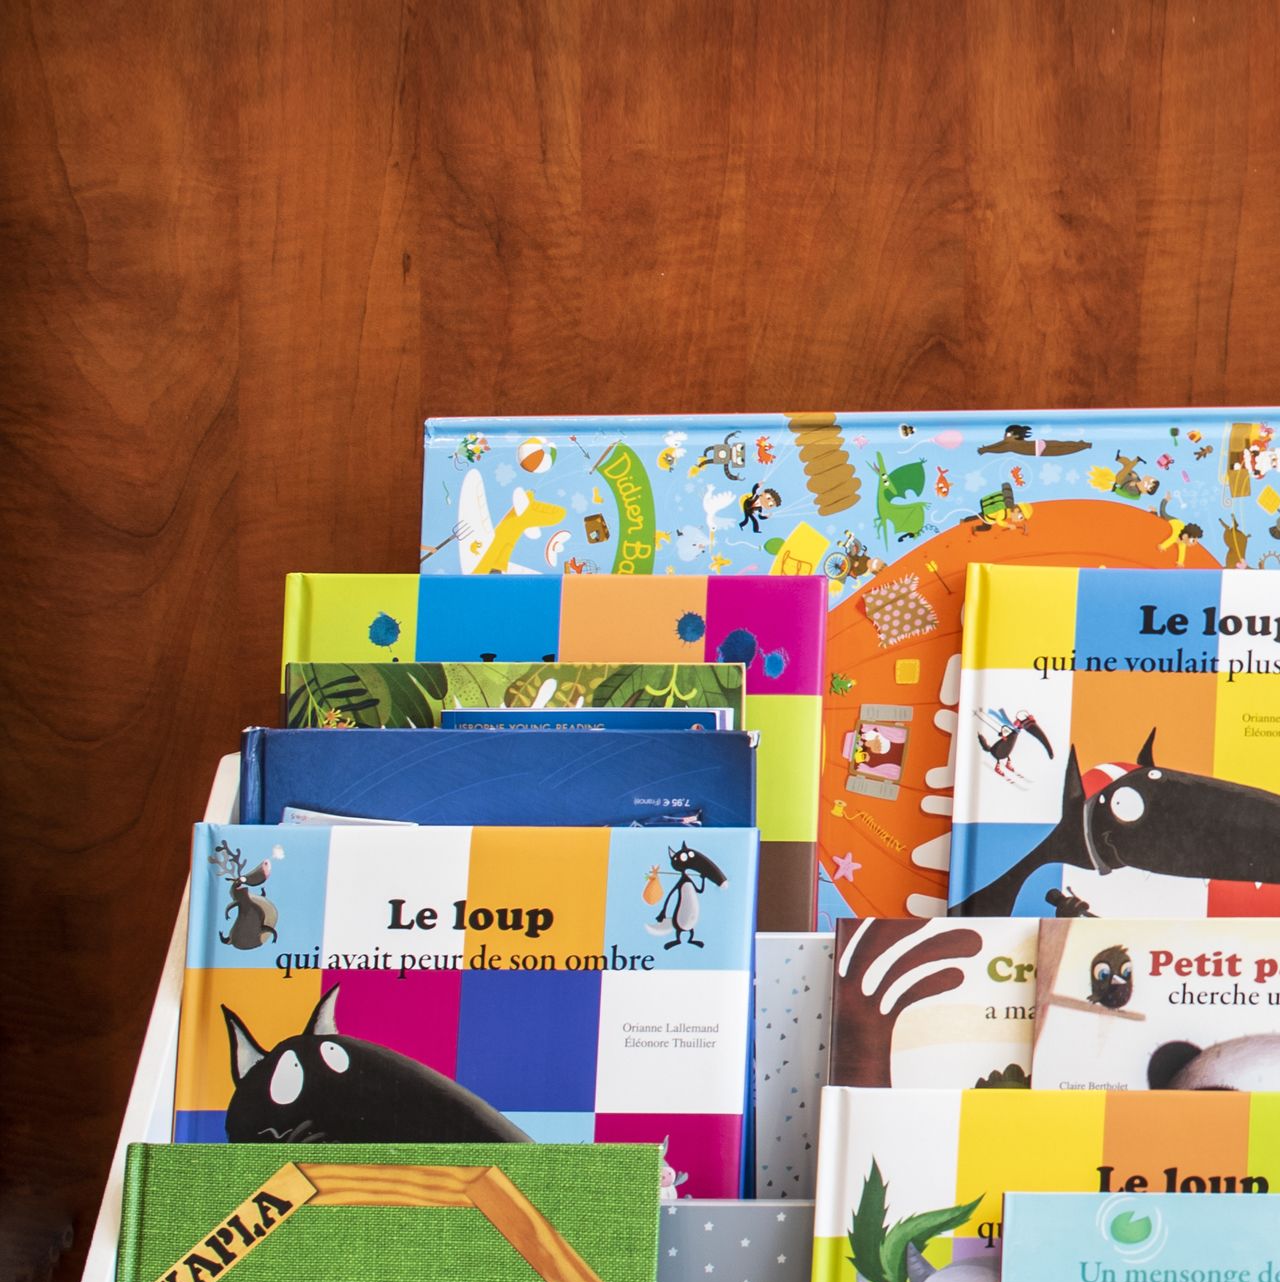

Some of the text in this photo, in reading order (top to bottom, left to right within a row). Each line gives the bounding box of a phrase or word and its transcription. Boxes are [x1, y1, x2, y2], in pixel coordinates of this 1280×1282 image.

[604, 452, 644, 534] Didier
[1139, 605, 1189, 636] Le
[1033, 650, 1077, 680] qui
[1086, 655, 1117, 673] ne
[1124, 648, 1219, 674] voulait
[1242, 713, 1280, 724] Orianne
[387, 899, 554, 938] Le loup
[276, 945, 655, 979] qui avait peur de son ombre
[1149, 950, 1242, 978] Petit
[1169, 984, 1260, 1006] cherche
[985, 1007, 997, 1020] a
[623, 1022, 719, 1034] Orianne Lallemand
[624, 1035, 716, 1048] Éléonore Thuillier
[1059, 1081, 1086, 1090] Claire
[1097, 1166, 1269, 1194] Le loup
